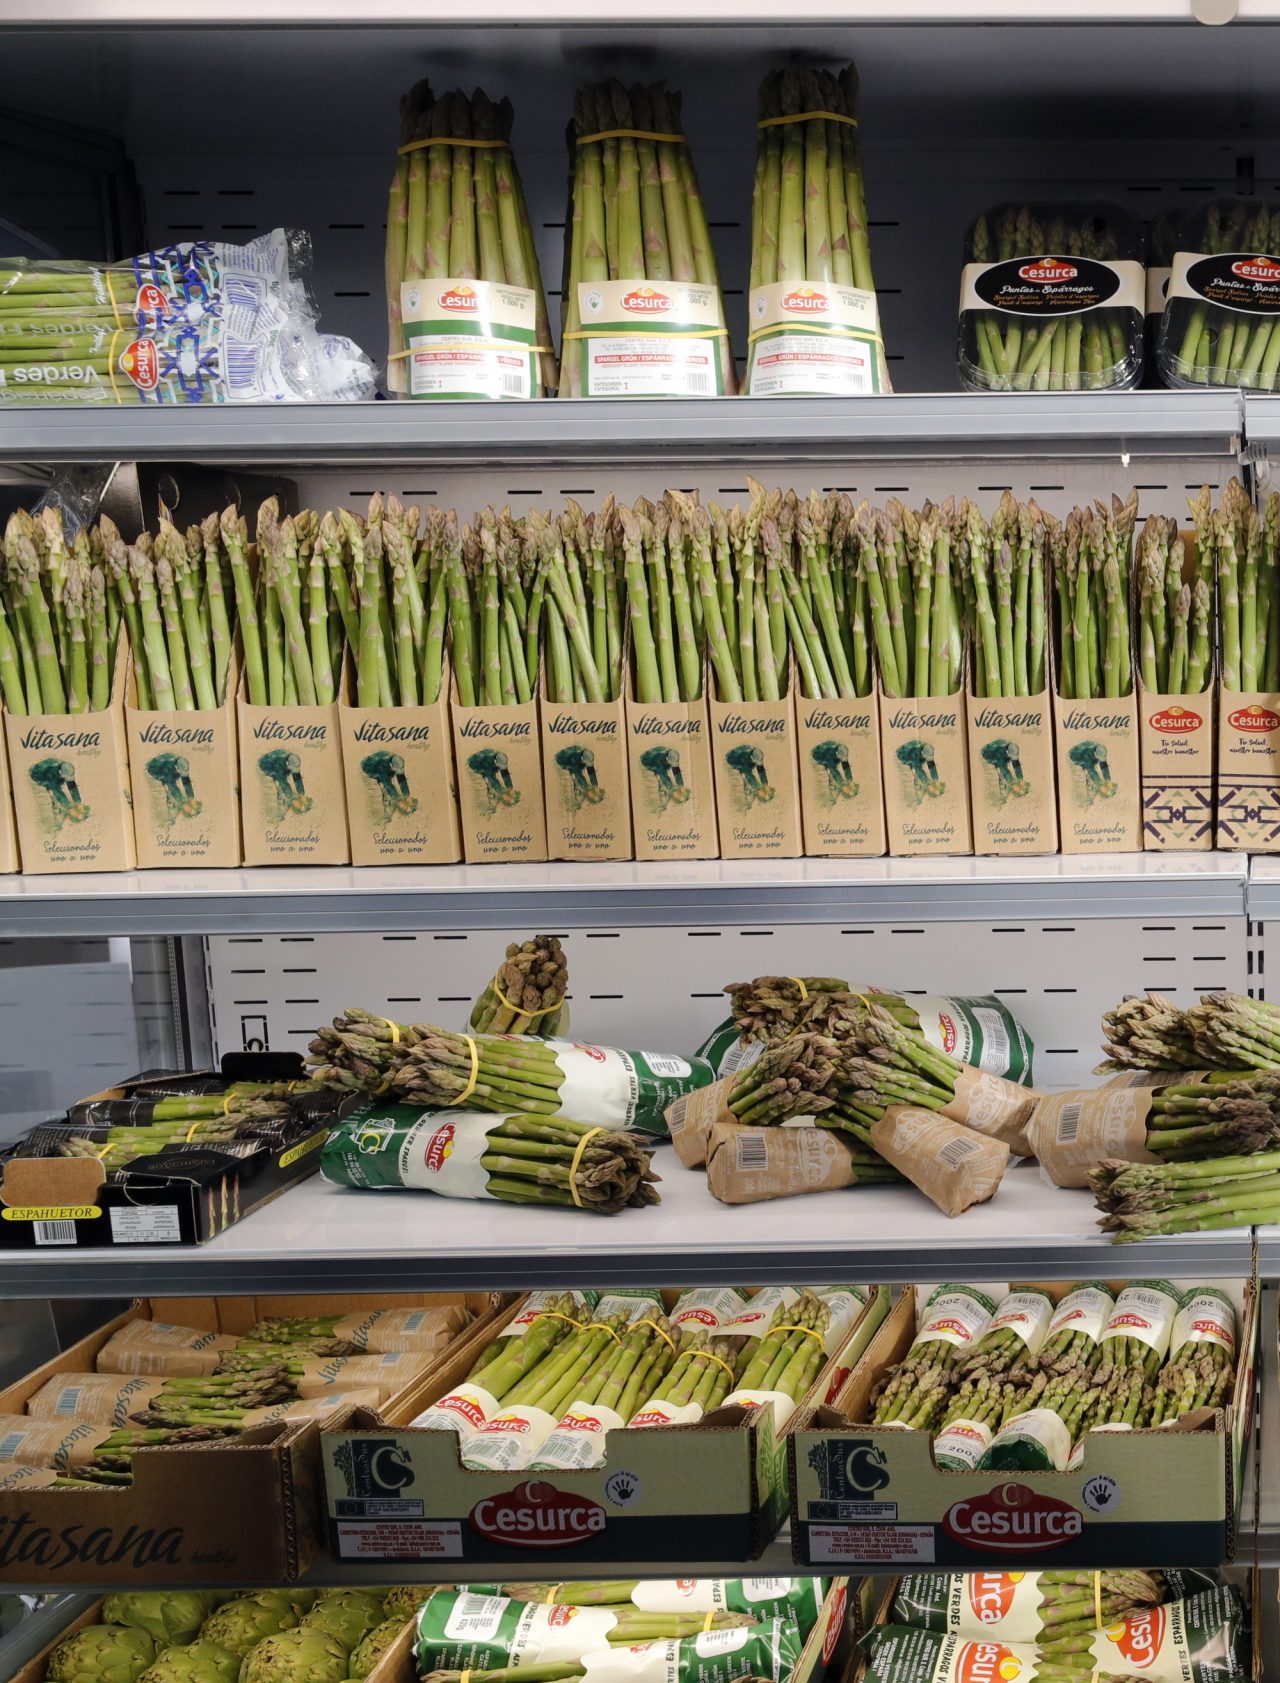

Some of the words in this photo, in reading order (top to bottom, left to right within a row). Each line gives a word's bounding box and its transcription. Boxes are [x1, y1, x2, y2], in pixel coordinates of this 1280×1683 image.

[1019, 265, 1078, 278] Cesurca
[1000, 284, 1034, 294] Puntas
[1042, 284, 1095, 294] Espárragos
[1211, 278, 1245, 289] Puntas
[439, 293, 482, 306] Cesur
[622, 294, 673, 308] Cesurca
[781, 296, 831, 309] Cesurca
[136, 339, 151, 387] Cesurca
[14, 365, 99, 385] Verdes
[548, 712, 618, 736] Vitasana
[633, 712, 701, 736] Vitasana
[718, 712, 785, 735] Vitasana
[804, 707, 870, 730] Vitasana
[889, 707, 956, 730] Vitasana
[974, 706, 1042, 729] Vitasana
[1062, 708, 1131, 730] Vitasana
[1151, 715, 1199, 728] Cesurca
[1230, 713, 1278, 727] Cesurca
[139, 719, 214, 744] Vitasana
[253, 716, 327, 741] Vitasana
[353, 715, 430, 742] Vitasana
[459, 713, 531, 739] Vitasana
[20, 724, 101, 749] Vitasana
[562, 828, 615, 841] Seleccionados
[647, 829, 701, 842] Seleccionados
[732, 828, 785, 840] Seleccionados
[817, 823, 870, 836] Seleccionados
[902, 823, 955, 836] Seleccionados
[987, 823, 1040, 835] Seleccionados
[1073, 823, 1127, 835] Seleccionados
[156, 834, 211, 847] Seleccionados
[265, 831, 320, 843] Seleccionados
[373, 832, 428, 845] Seleccionados
[476, 832, 532, 844] Seleccionados
[43, 840, 101, 853] Seleccionados
[298, 844, 315, 852] uno
[512, 844, 528, 852] uno
[428, 1122, 456, 1173] Cesurca
[11, 1207, 94, 1219] ESPAHUETOR
[436, 1396, 488, 1429] Cesurca
[560, 1418, 602, 1433] surca
[473, 1500, 607, 1531] Cesurca
[948, 1503, 1083, 1536] Cesurca
[0, 1511, 184, 1570] itasana
[979, 1573, 1004, 1625] urca
[950, 1587, 962, 1626] VERDES
